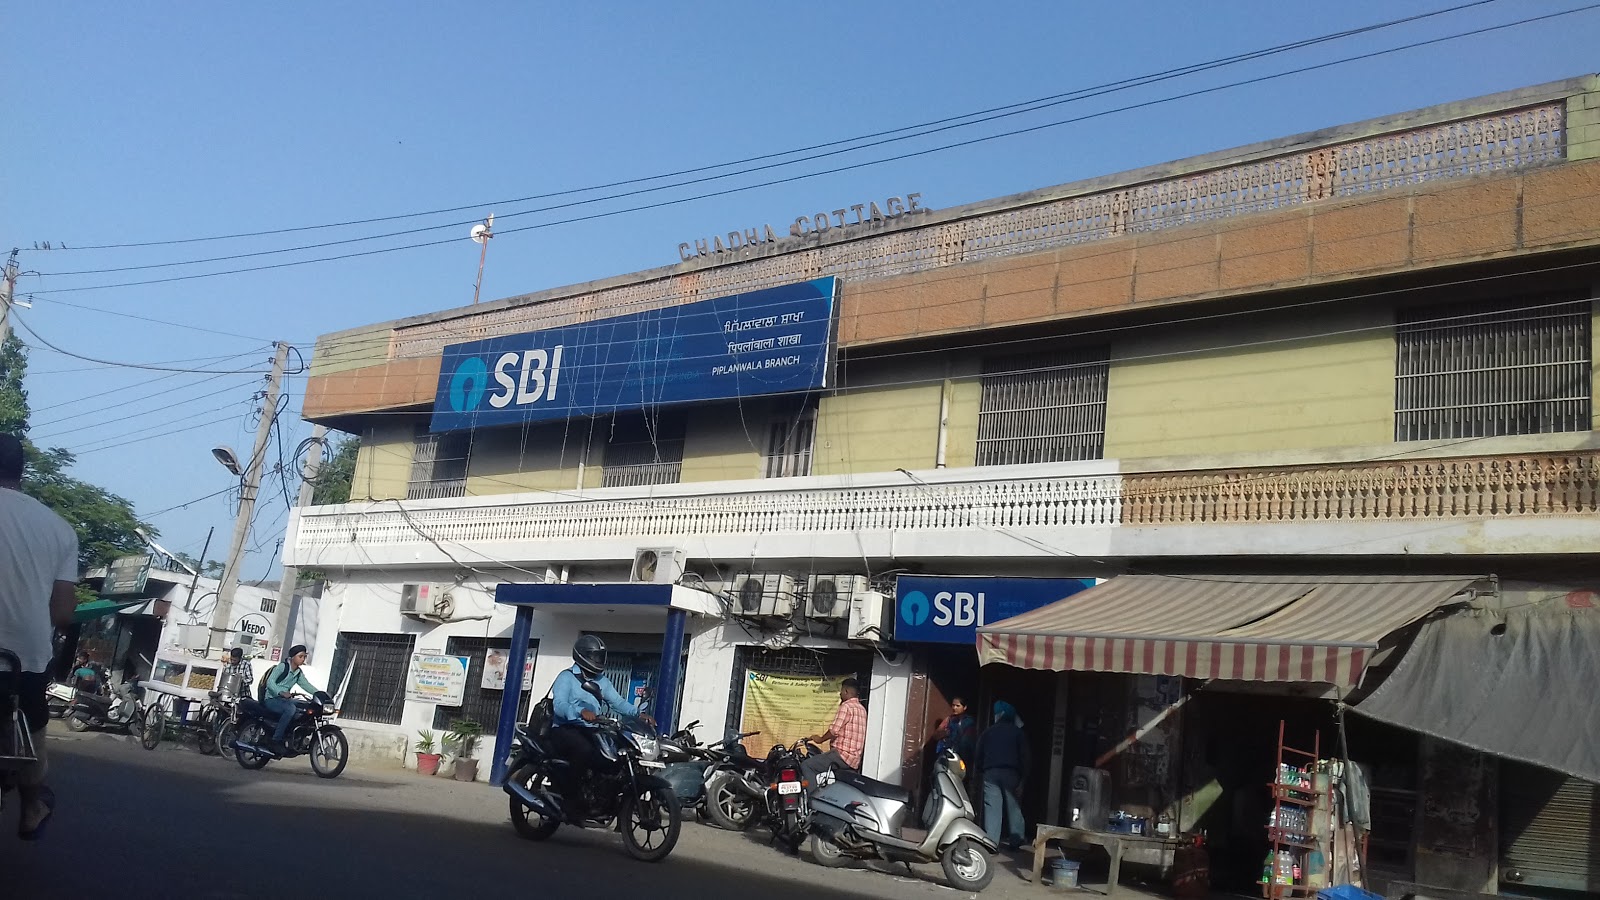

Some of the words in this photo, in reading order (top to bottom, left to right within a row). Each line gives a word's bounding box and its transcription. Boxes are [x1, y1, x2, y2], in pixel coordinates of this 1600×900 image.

[678, 223, 778, 262] CHADHA
[794, 192, 921, 237] COTTAGE
[728, 338, 775, 354] पिपलांवाला
[777, 333, 802, 347] शाखा
[489, 344, 563, 408] SBI
[711, 360, 762, 376] PIPLANWALA
[764, 355, 800, 369] BRANCH
[932, 591, 985, 627] SBI
[241, 619, 265, 635] VEEDO
[755, 673, 769, 682] SBI
